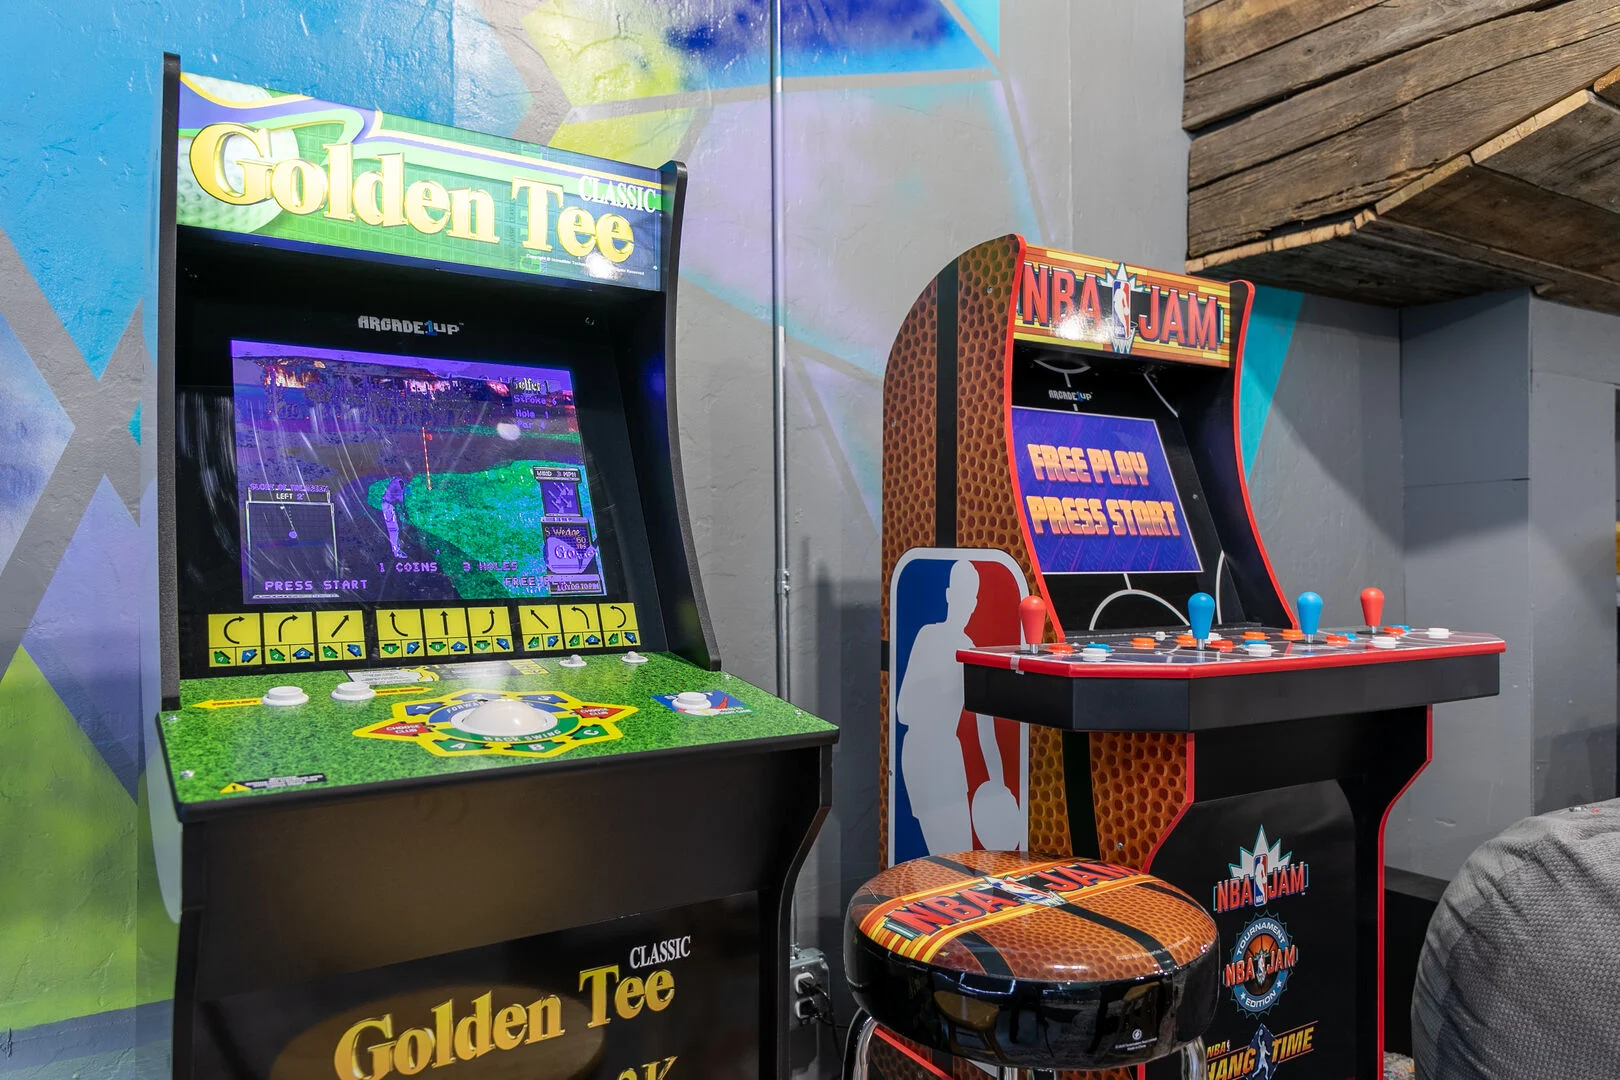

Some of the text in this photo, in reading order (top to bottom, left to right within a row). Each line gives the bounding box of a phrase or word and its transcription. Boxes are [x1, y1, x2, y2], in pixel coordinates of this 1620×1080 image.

[188, 122, 635, 263] Golden Tee
[578, 175, 657, 213] CLASSIC
[1022, 262, 1219, 350] NBA JAM
[358, 315, 460, 336] ARCADE1UP
[515, 409, 536, 418] Hole
[1027, 443, 1149, 486] FREE PLAY
[1026, 496, 1180, 537] PRESS START
[379, 561, 518, 572] 1 COINS 3 HOLES
[505, 577, 536, 586] FREE
[265, 579, 368, 591] PRESS START
[524, 729, 562, 740] SWING
[886, 861, 1140, 936] NBA JAM
[1217, 861, 1305, 913] NBA JAM
[629, 935, 691, 970] CLASSIC
[1236, 922, 1285, 956] TOURNAMENT
[1225, 944, 1297, 987] NBA JAM
[1245, 990, 1278, 1008] EDITION
[333, 964, 675, 1080] Golden Tee
[1206, 1041, 1226, 1059] NBA
[1272, 1026, 1315, 1063] TIME
